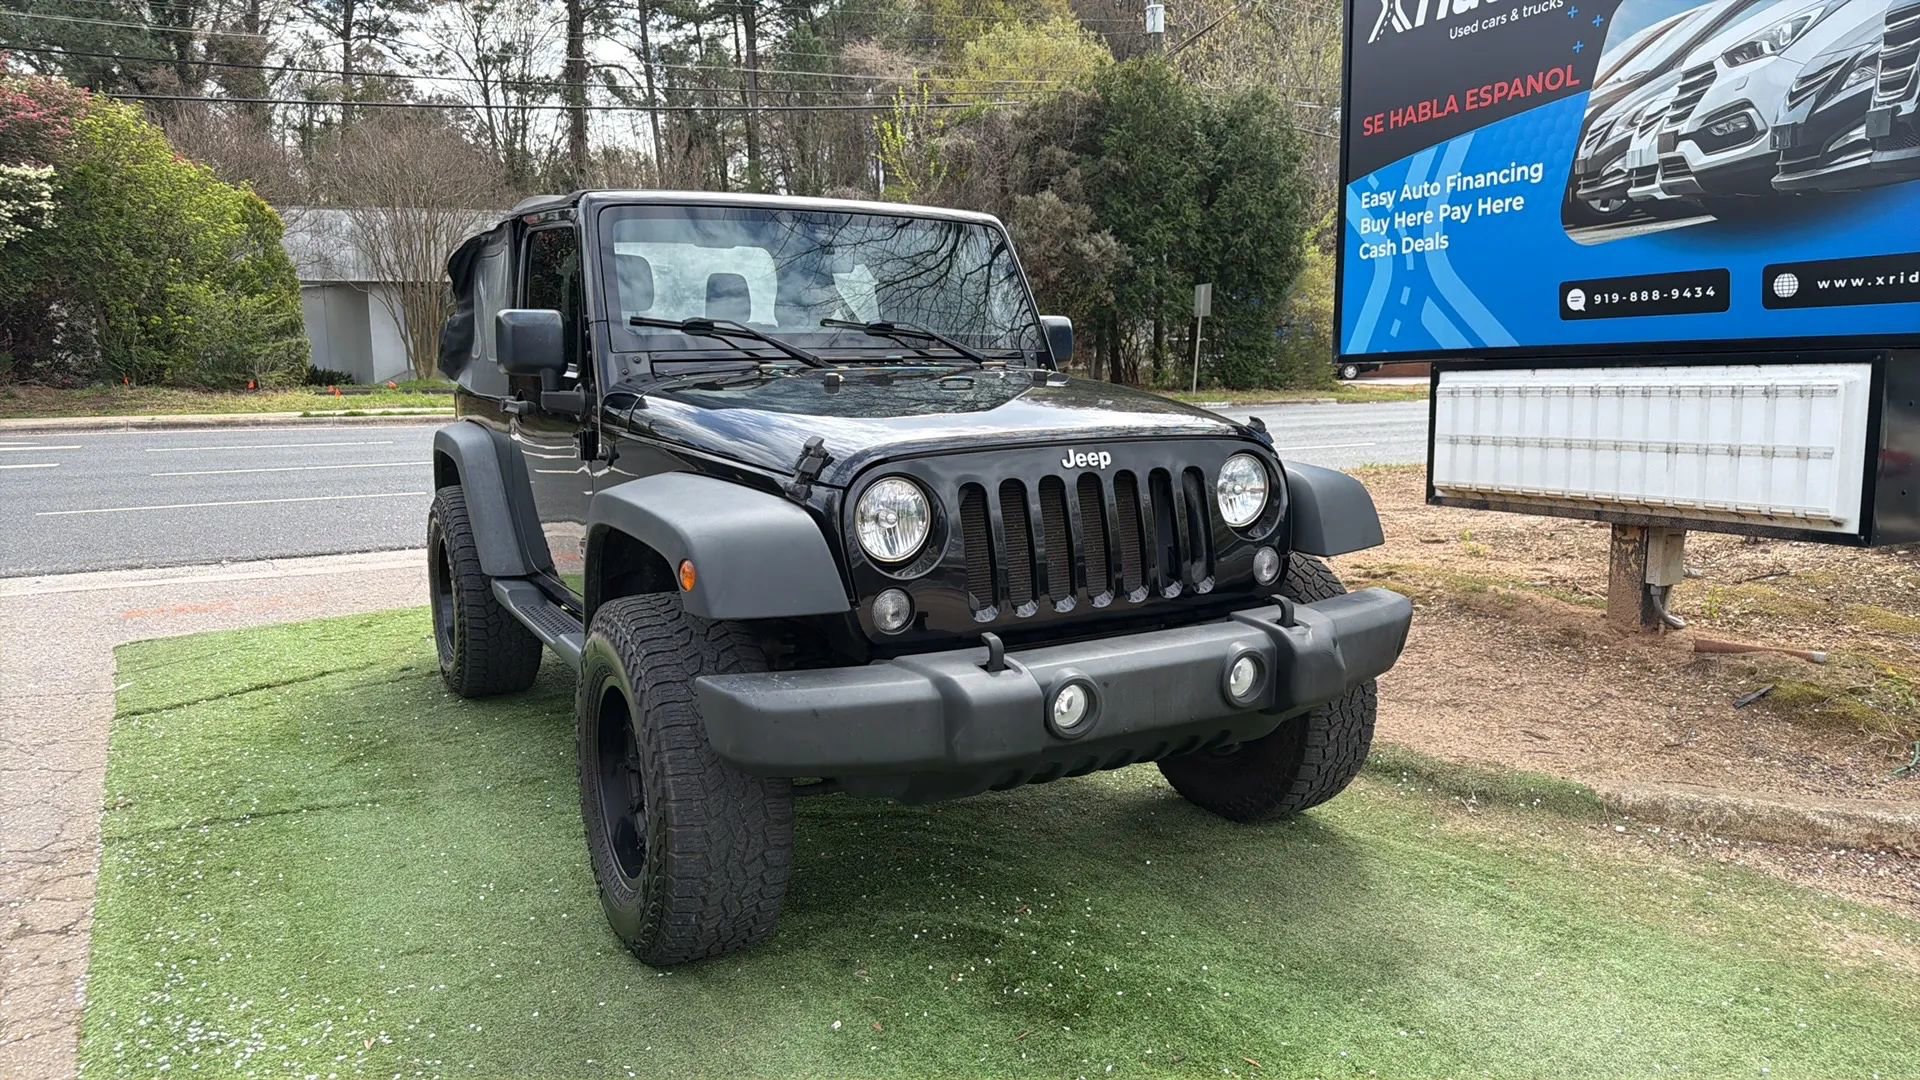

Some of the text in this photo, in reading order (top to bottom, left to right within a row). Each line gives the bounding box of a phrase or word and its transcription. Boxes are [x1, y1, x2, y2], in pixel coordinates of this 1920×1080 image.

[1449, 20, 1479, 40] Used
[1481, 12, 1508, 30] cars
[1510, 8, 1520, 22] &
[1522, 0, 1564, 17] trucks
[1362, 64, 1581, 136] SE HABLA ESPANOL
[1361, 160, 1544, 209] Easy Auto Financing
[1360, 195, 1525, 235] Buy Here Pay Here
[1359, 232, 1449, 260] Cash Deals
[1593, 286, 1716, 304] 919-888-9434
[1061, 448, 1112, 470] Jeep
